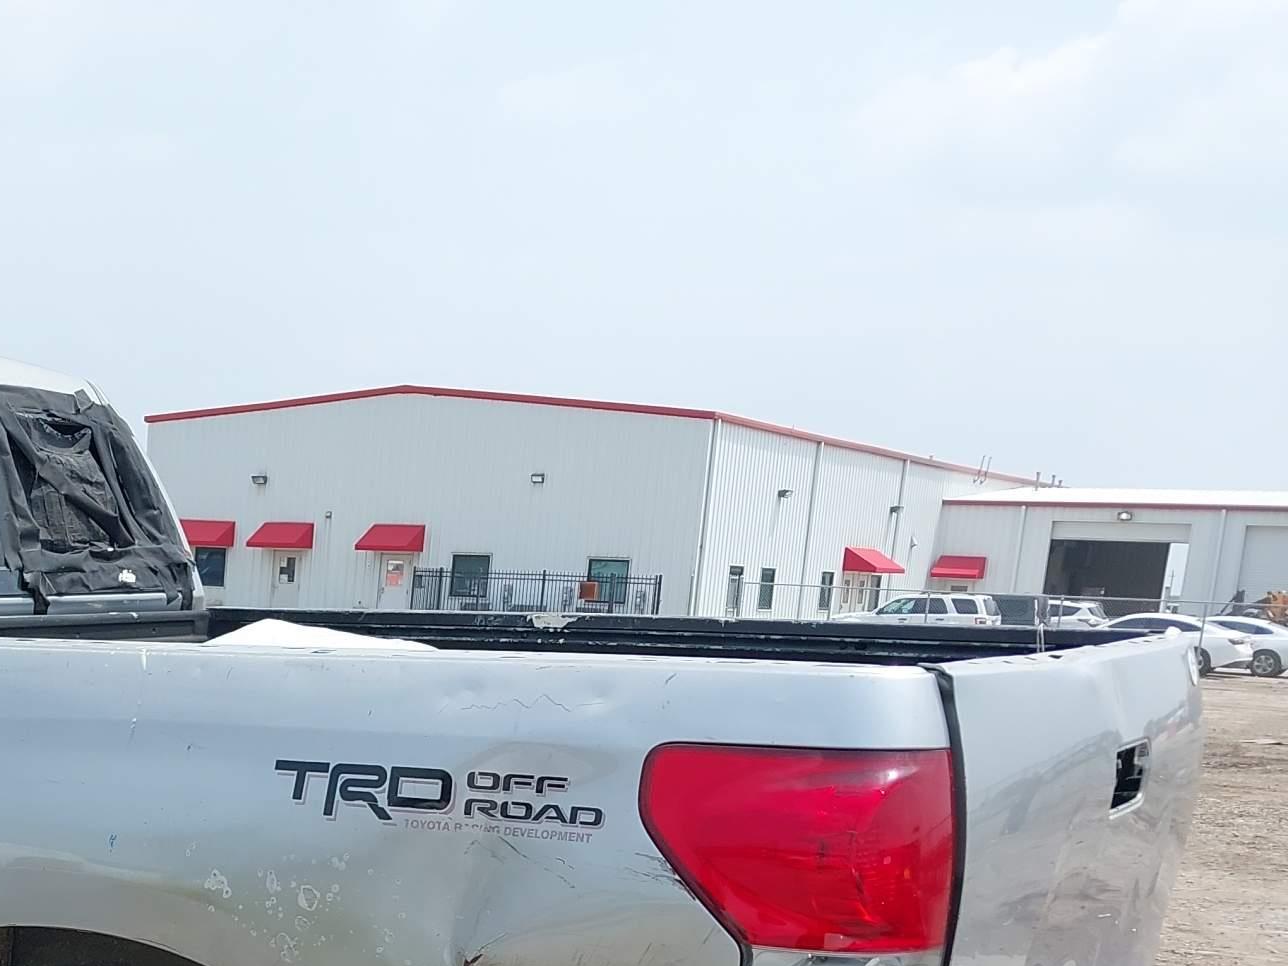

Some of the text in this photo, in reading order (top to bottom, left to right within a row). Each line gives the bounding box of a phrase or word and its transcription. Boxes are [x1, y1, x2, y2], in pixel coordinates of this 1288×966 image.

[274, 759, 454, 821] TRD
[466, 771, 570, 794] OFF
[463, 799, 606, 828] ROAD
[404, 818, 450, 832] TOYOTA
[504, 826, 593, 844] DEVELOPMENT
